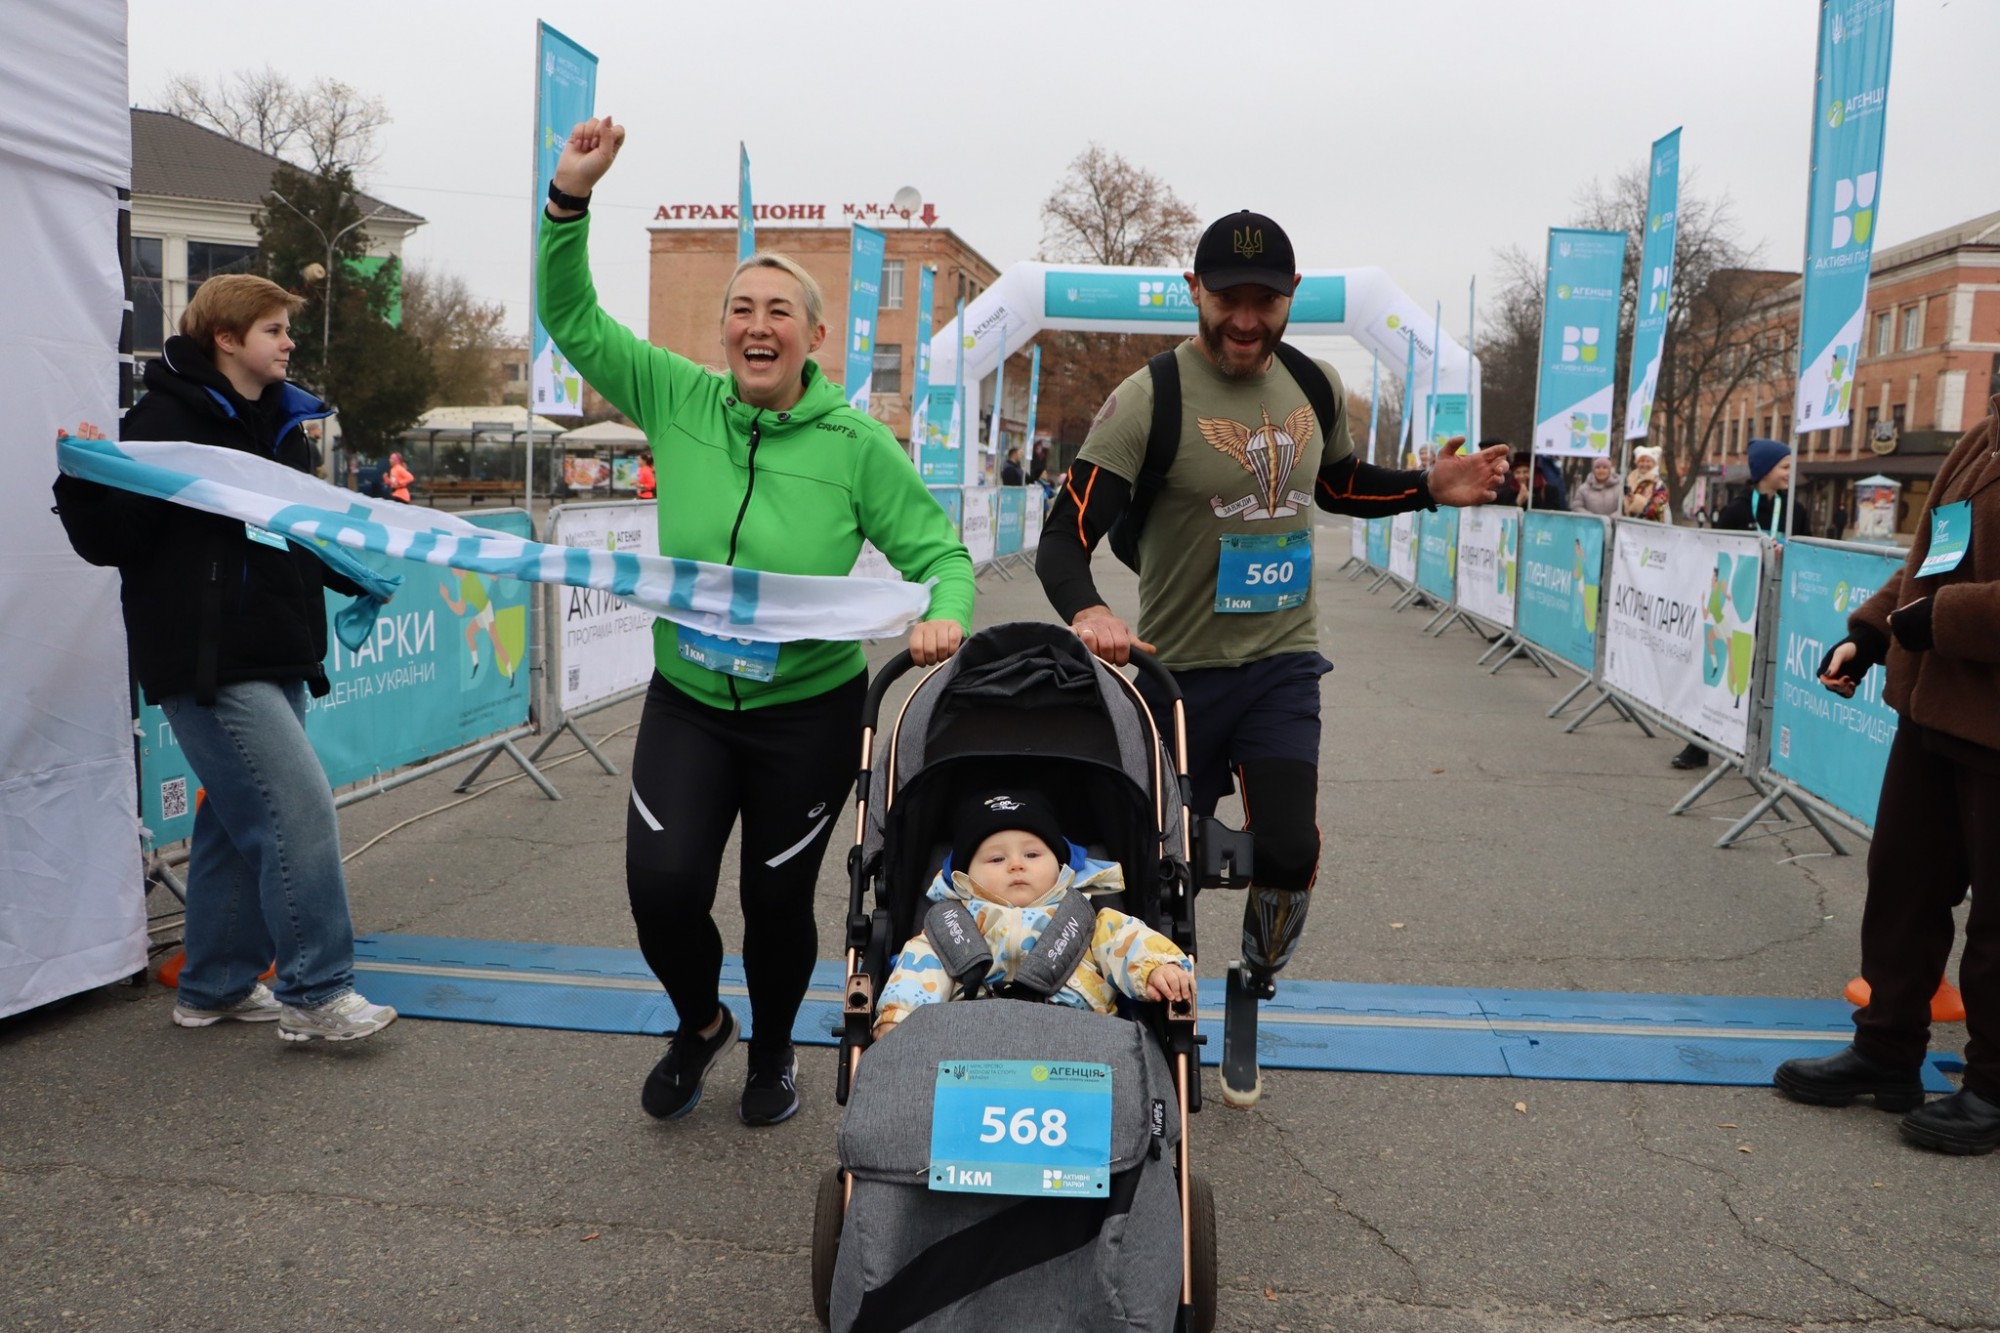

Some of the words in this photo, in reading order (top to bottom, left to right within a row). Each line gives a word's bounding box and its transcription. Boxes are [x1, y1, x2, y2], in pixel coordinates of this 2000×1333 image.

[816, 422, 849, 434] CRAFT
[1222, 497, 1252, 515] ЗАВЖДИ
[1245, 561, 1294, 585] 560
[1652, 597, 1697, 641] ПАРКИ
[304, 676, 374, 713] ЗИДЕНТА
[375, 660, 435, 695] УКРАЇНИ
[1050, 1067, 1100, 1078] АГЕНЦІЯ
[979, 1106, 1067, 1146] 568
[1063, 1174, 1090, 1182] АКТИВНІ
[1063, 1180, 1085, 1188] ПАРКИ
